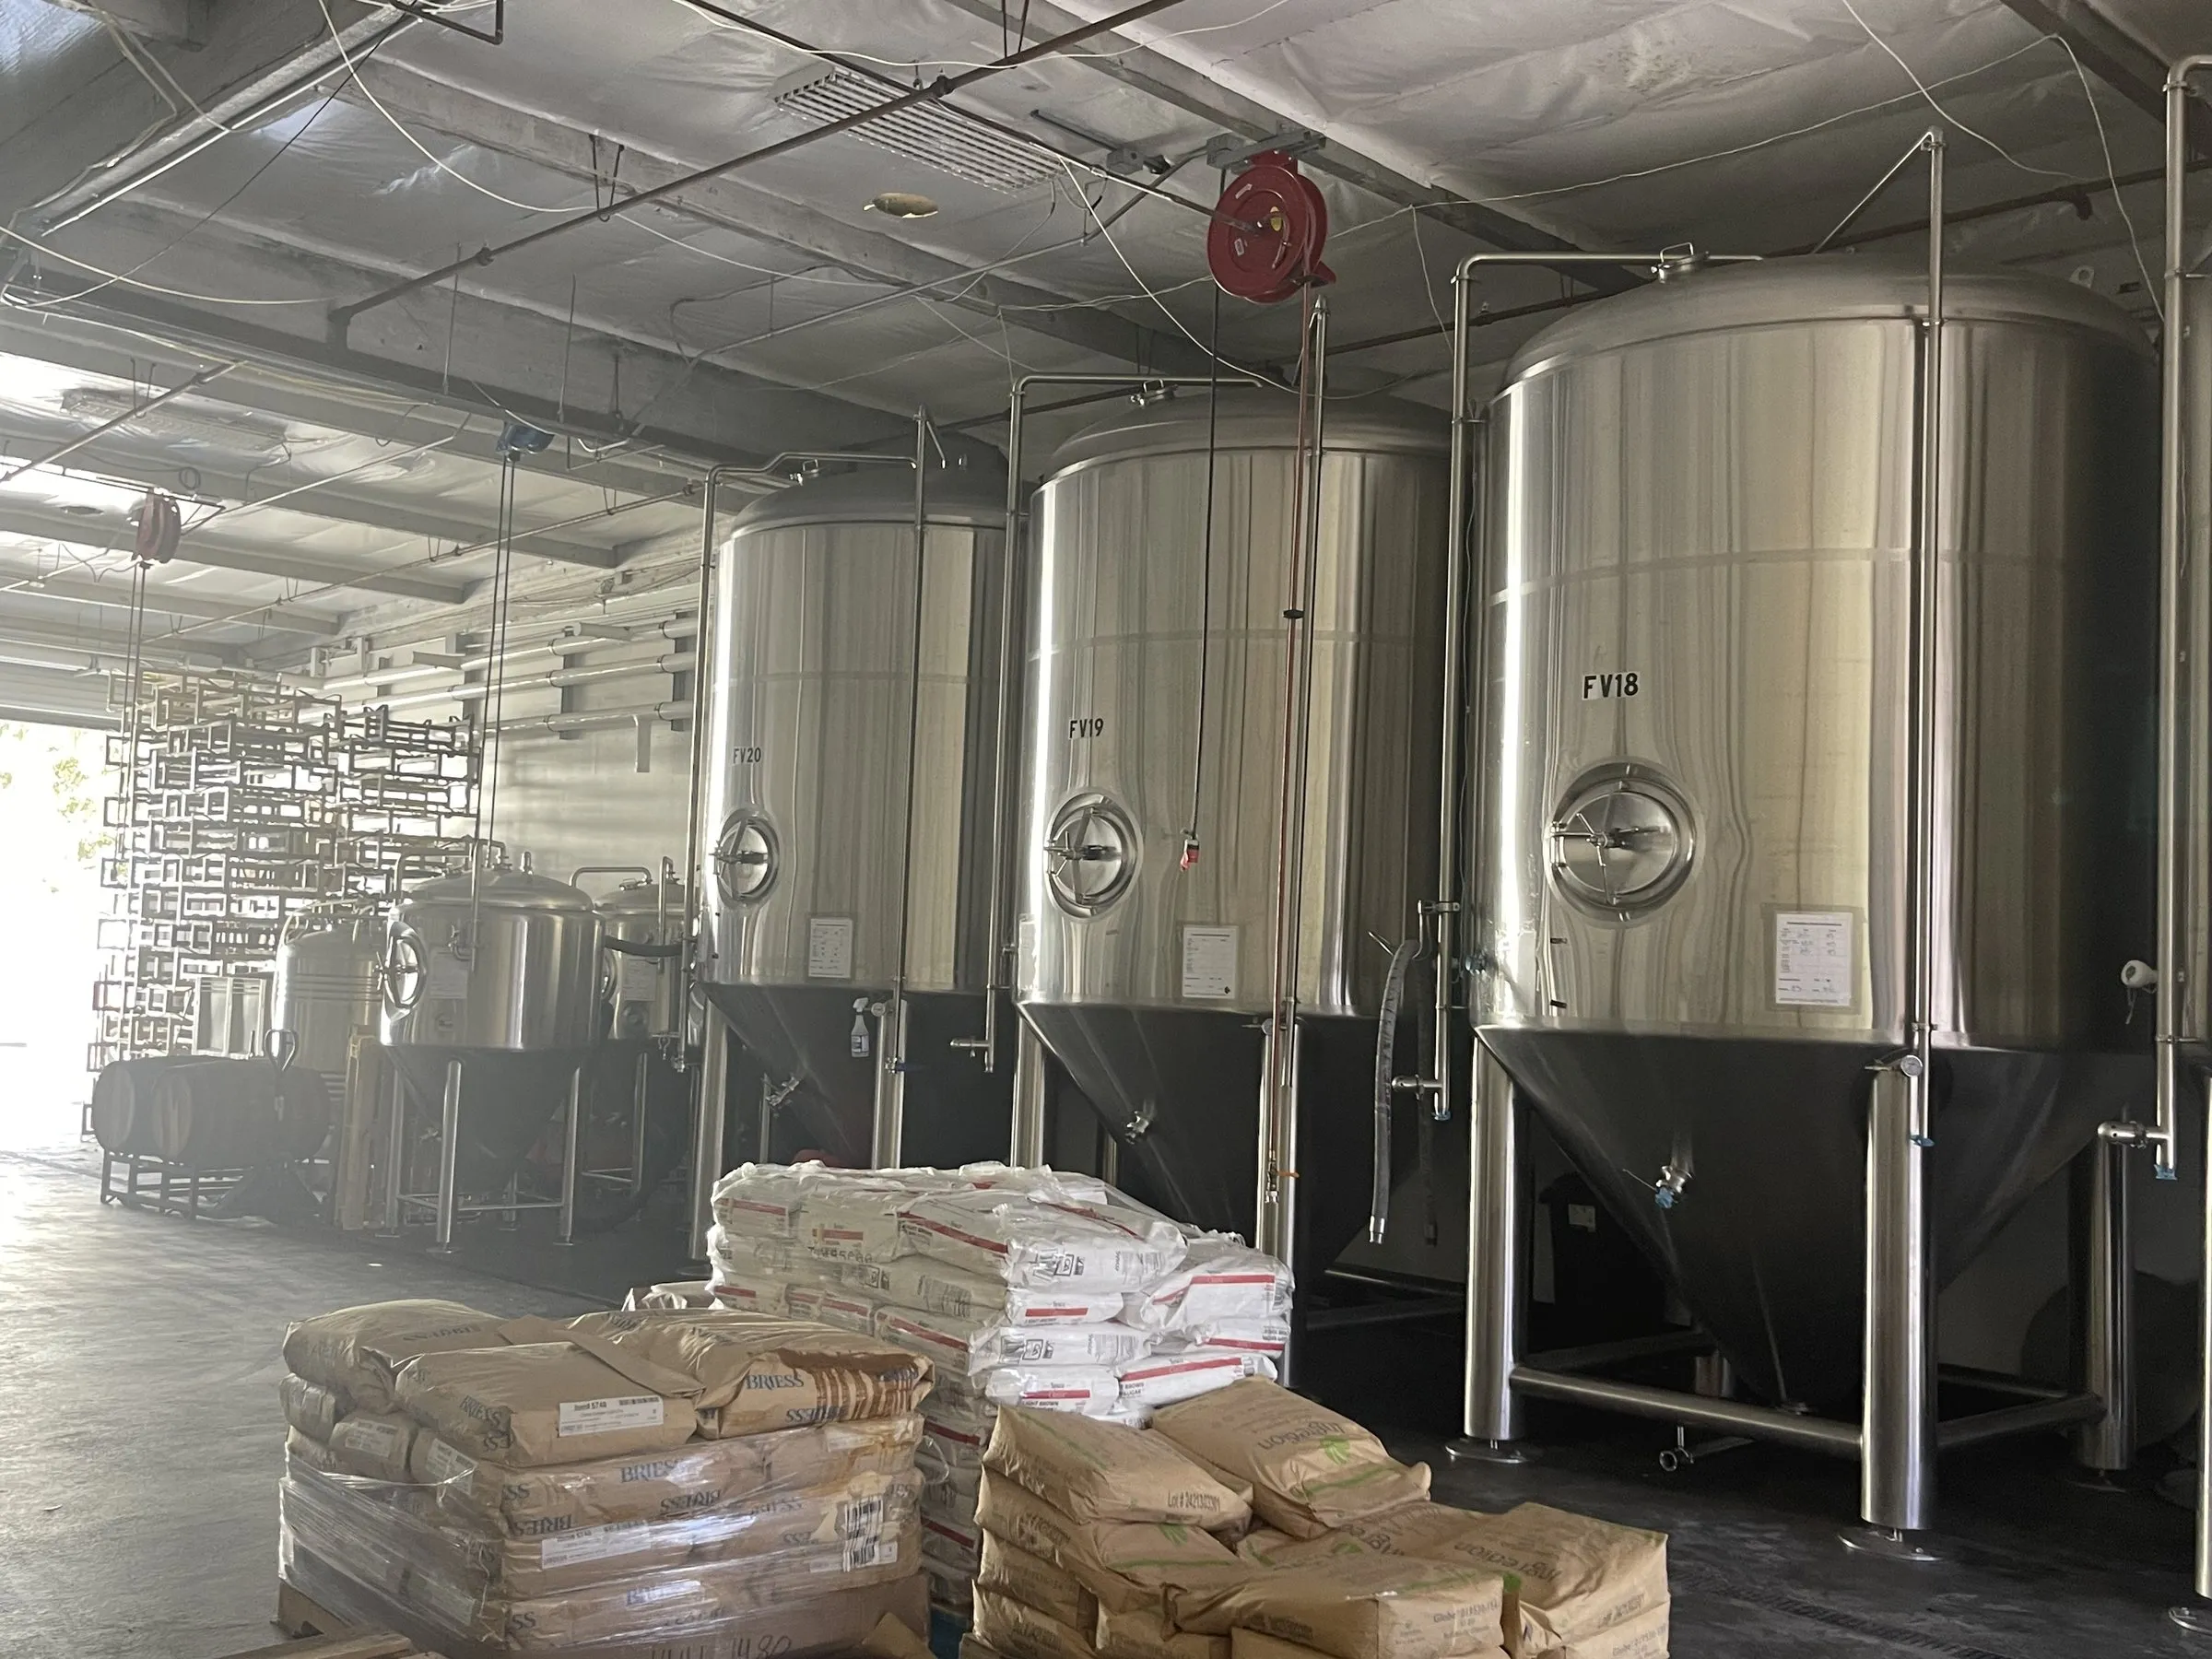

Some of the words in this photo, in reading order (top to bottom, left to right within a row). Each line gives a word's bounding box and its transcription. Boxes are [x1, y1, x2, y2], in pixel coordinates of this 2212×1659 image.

[1583, 673, 1639, 699] FV18
[1069, 718, 1104, 738] FV19
[733, 747, 762, 764] FV20
[746, 1372, 805, 1391] BRIESS
[660, 1488, 722, 1513] BRIESS
